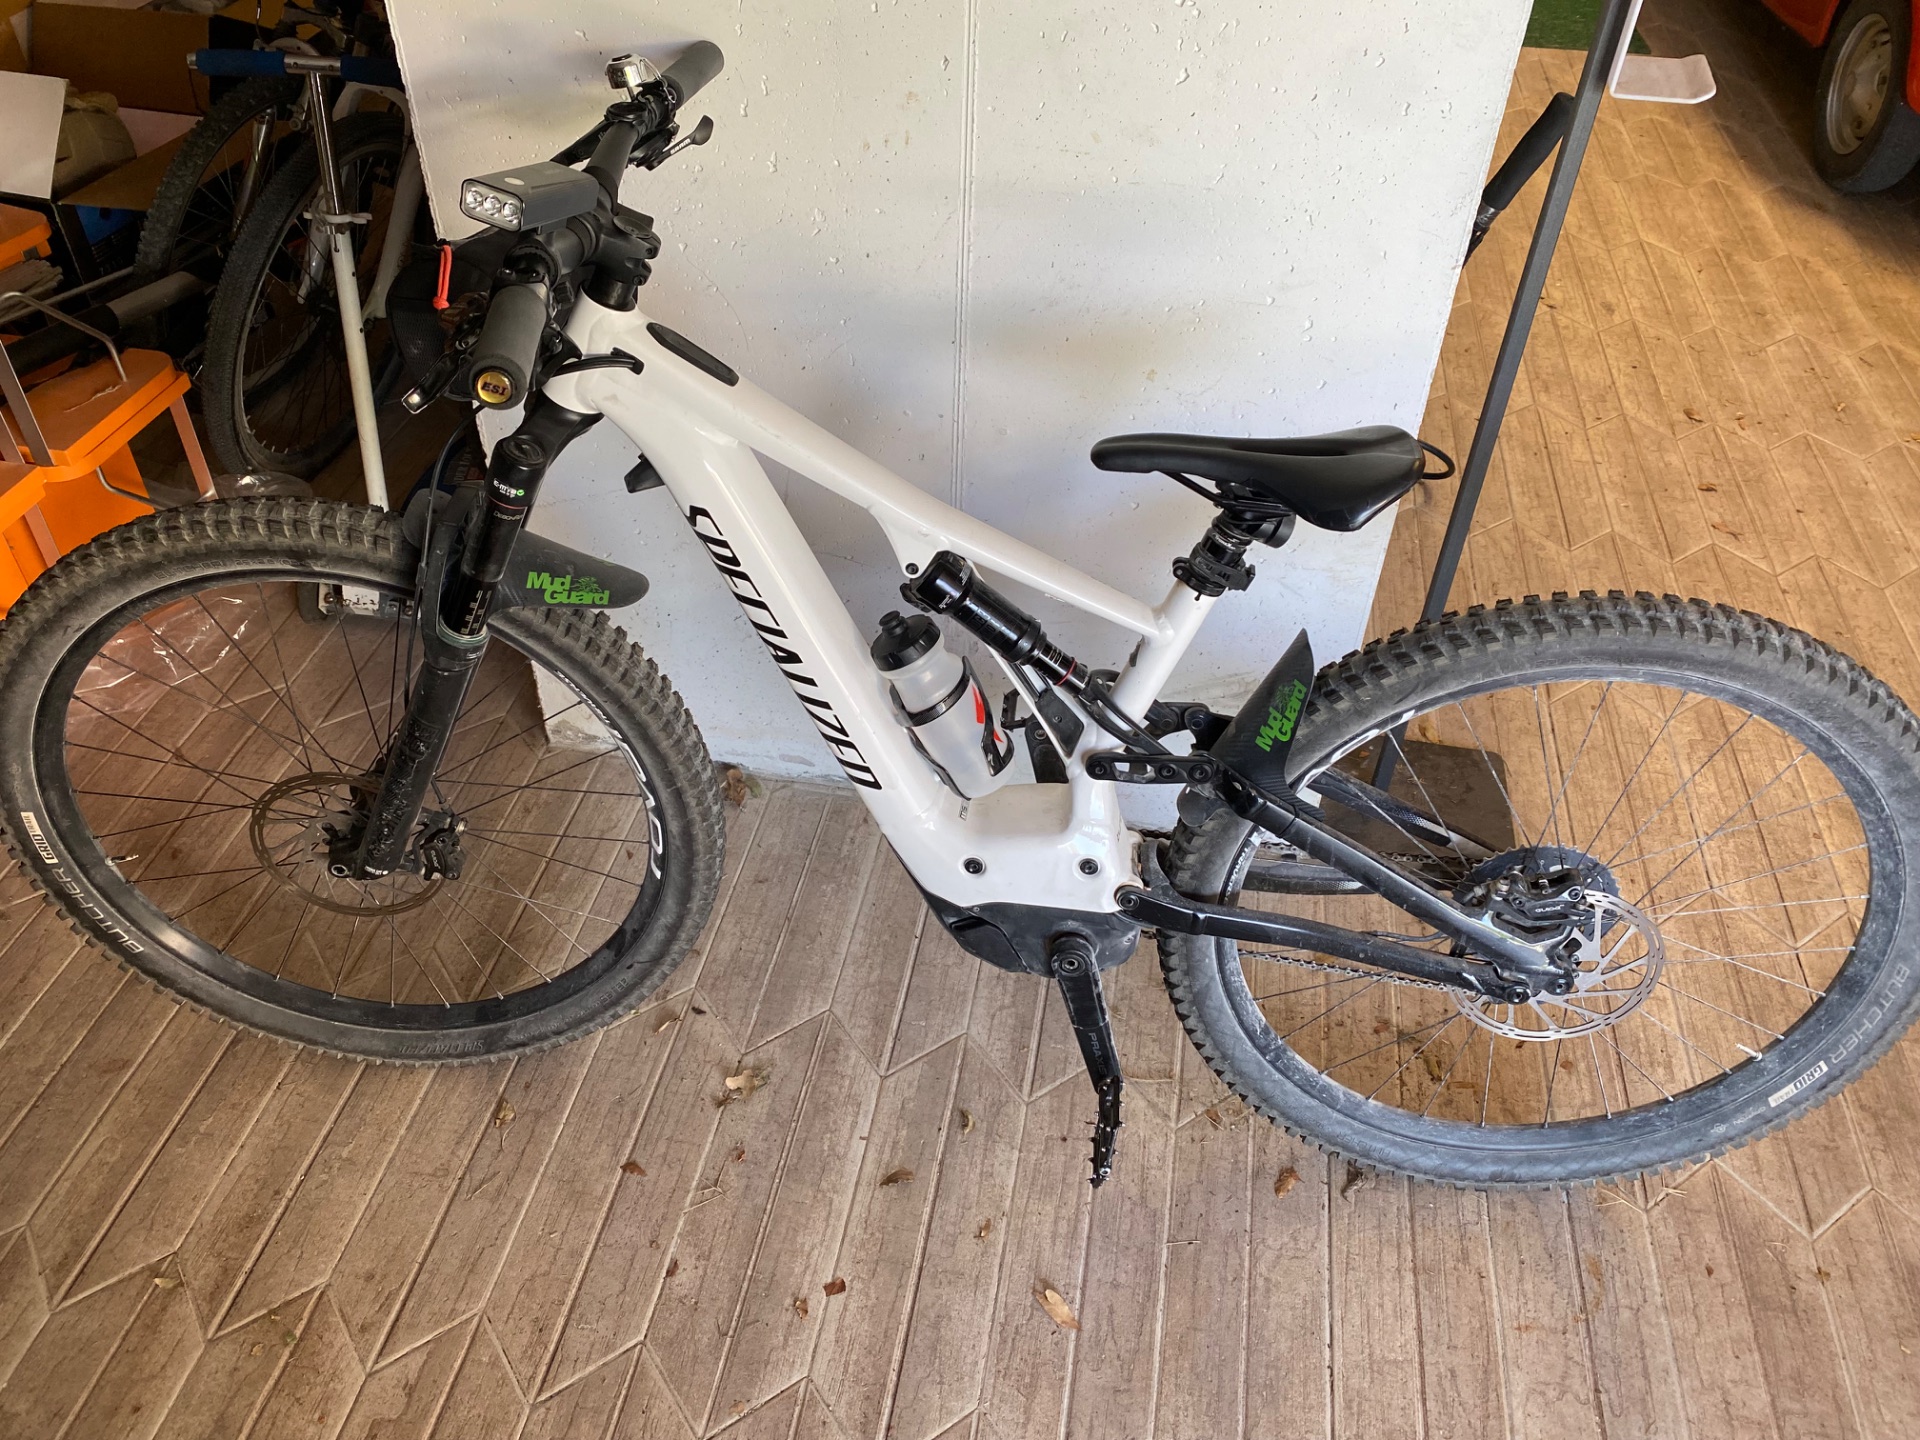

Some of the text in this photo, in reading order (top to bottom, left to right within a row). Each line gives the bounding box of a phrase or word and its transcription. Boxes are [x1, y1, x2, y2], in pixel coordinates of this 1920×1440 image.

[481, 381, 508, 396] ESI
[526, 571, 571, 590] Mud
[544, 587, 610, 605] Guard
[689, 505, 882, 790] SPECIALIZED
[1255, 706, 1283, 752] Mud
[1275, 679, 1307, 742] Guard
[31, 833, 55, 860] GRID
[52, 867, 145, 954] BUTCHER
[1829, 962, 1911, 1064] BUTCHER
[1088, 1032, 1107, 1076] PRAXIS
[1793, 1064, 1824, 1091] GRID
